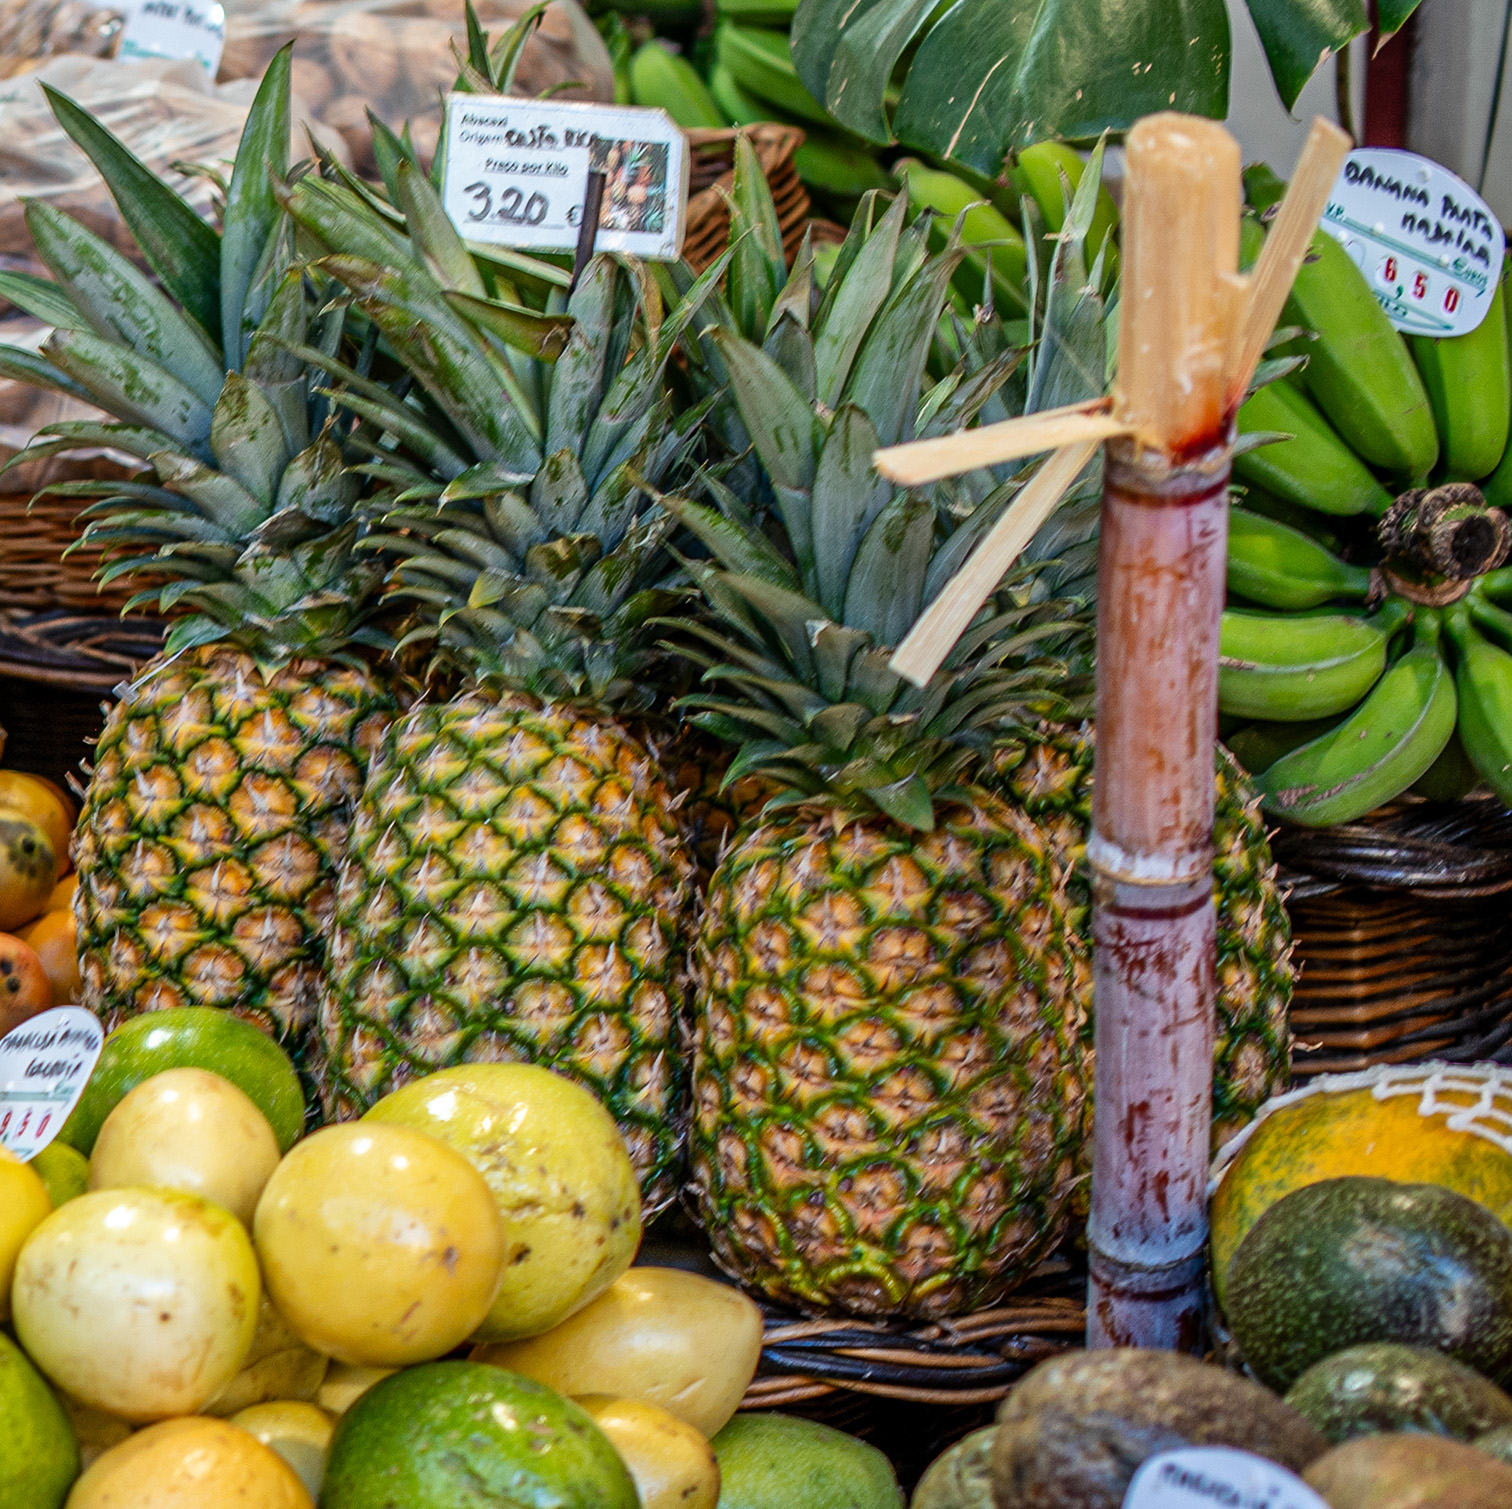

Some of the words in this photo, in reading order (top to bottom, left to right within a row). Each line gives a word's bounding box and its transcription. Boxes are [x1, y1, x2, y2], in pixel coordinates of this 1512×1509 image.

[484, 157, 519, 173] Preço
[520, 162, 543, 174] por
[544, 161, 569, 176] Kilo
